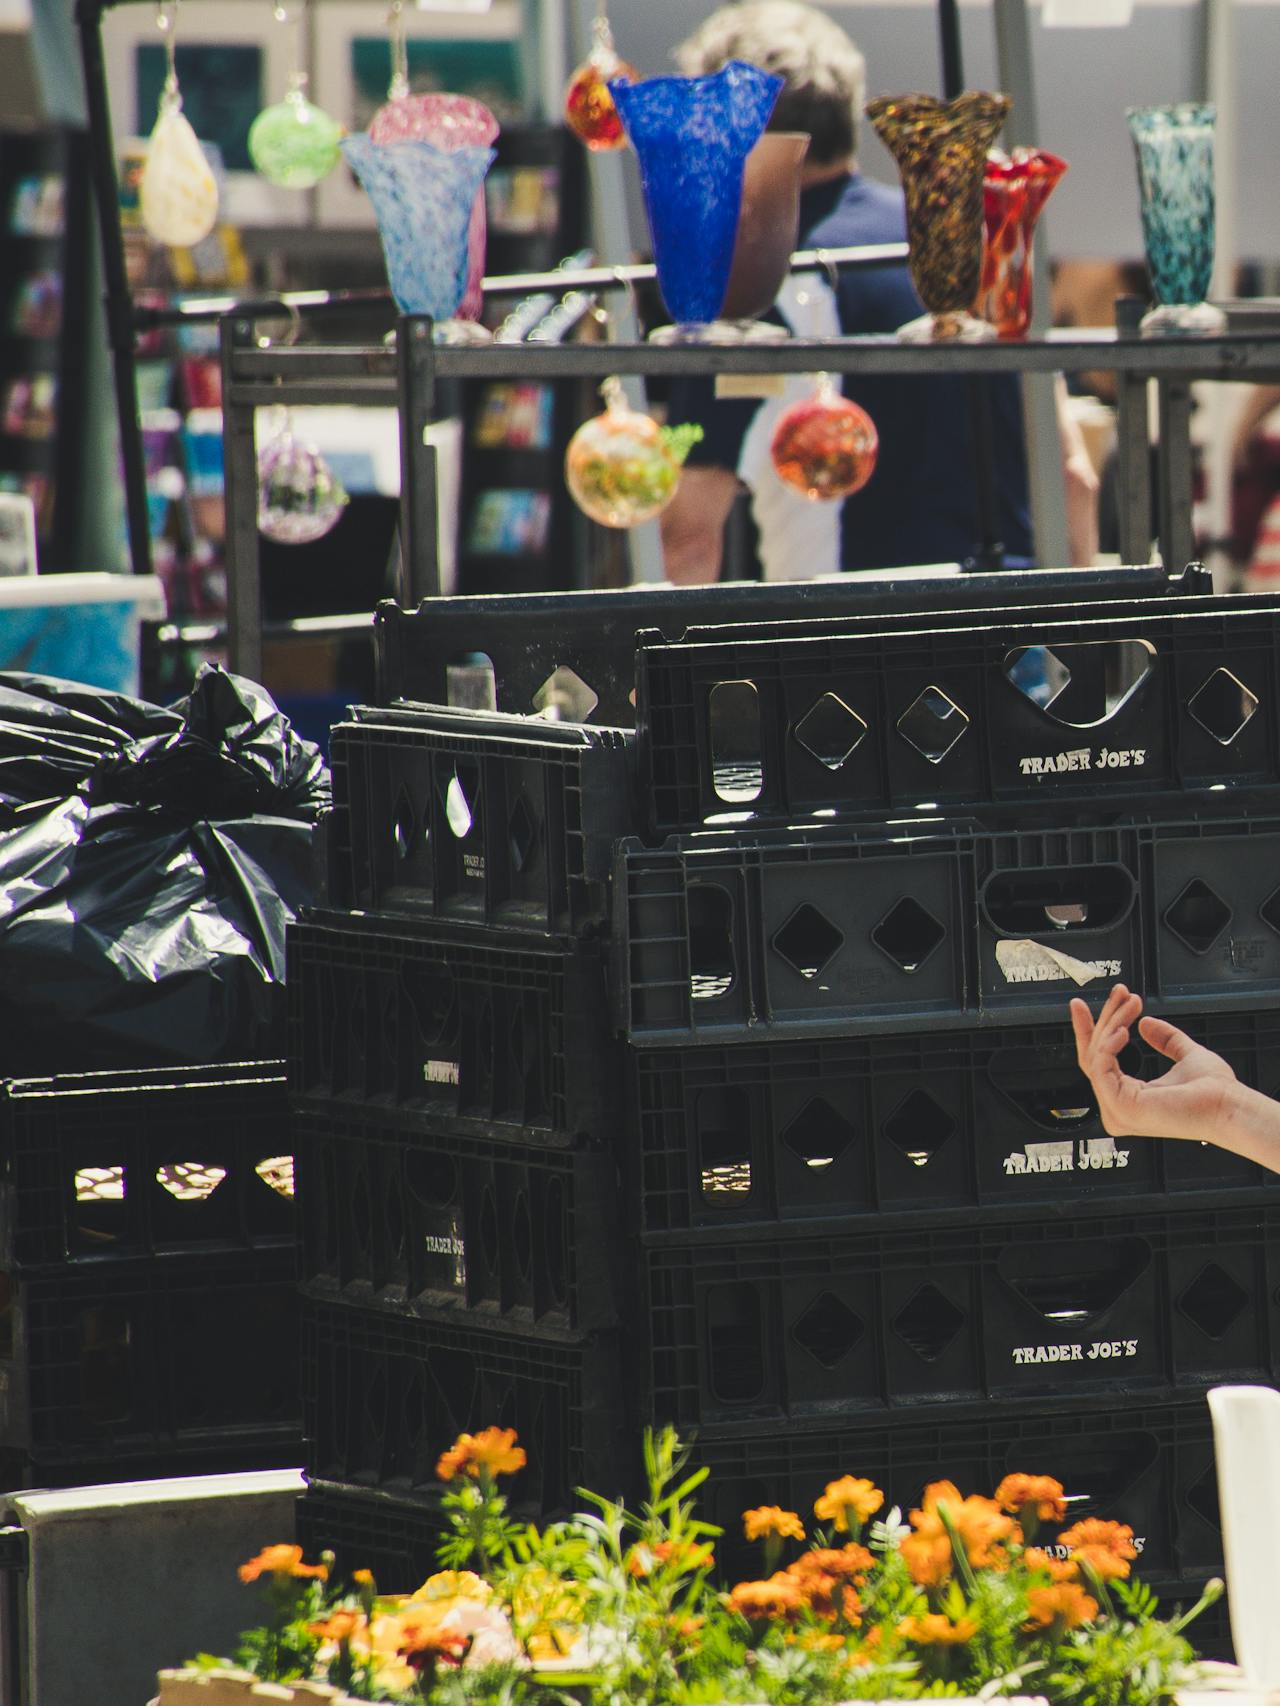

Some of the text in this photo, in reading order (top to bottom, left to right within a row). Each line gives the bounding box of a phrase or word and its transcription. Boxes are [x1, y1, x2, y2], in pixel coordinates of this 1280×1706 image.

[1019, 749, 1146, 774] TRADER JOE'S
[1003, 1151, 1130, 1174] TRADER JOE'S
[425, 1236, 452, 1254] TRADER
[1012, 1340, 1138, 1364] TRADER JOE'S
